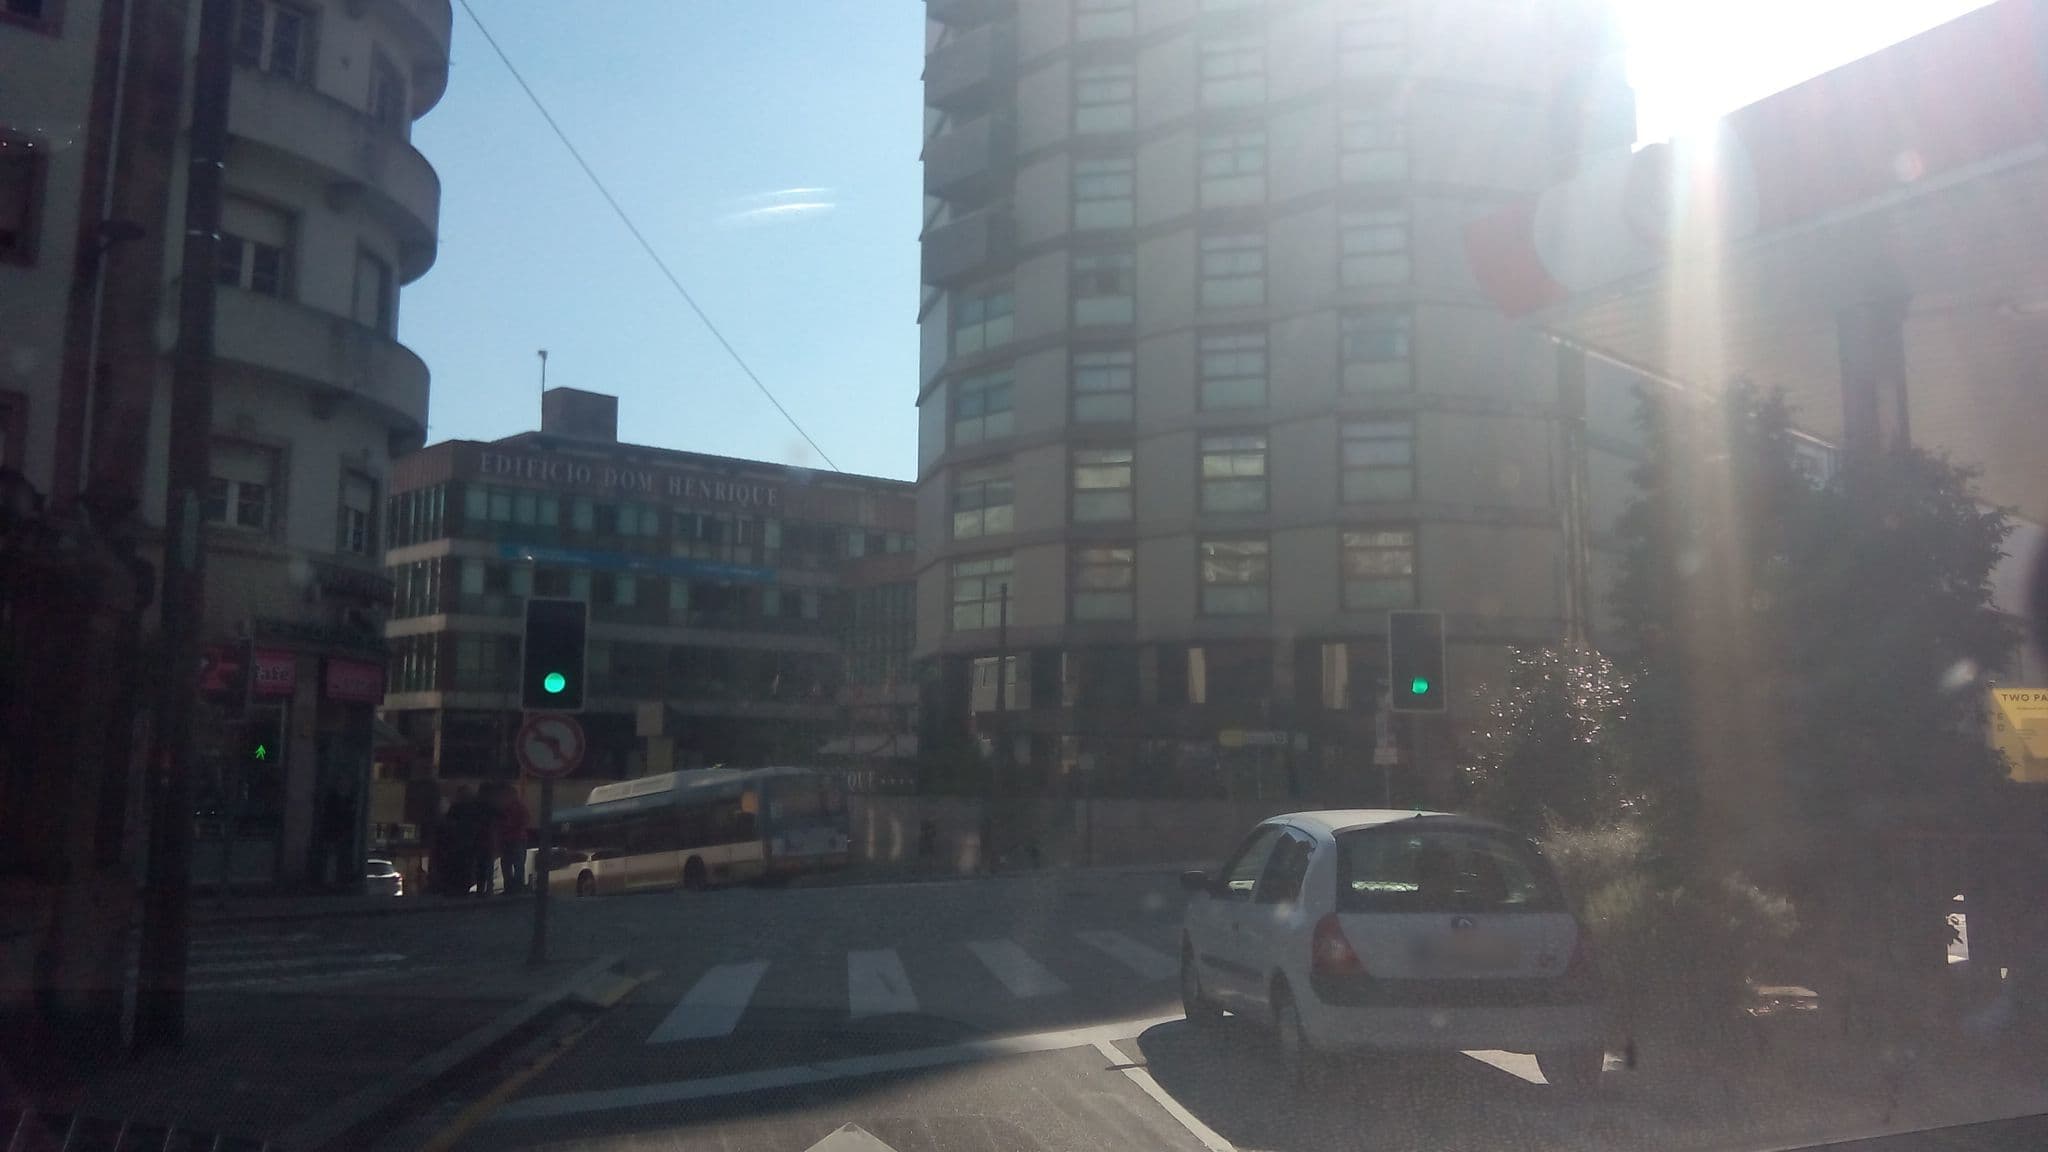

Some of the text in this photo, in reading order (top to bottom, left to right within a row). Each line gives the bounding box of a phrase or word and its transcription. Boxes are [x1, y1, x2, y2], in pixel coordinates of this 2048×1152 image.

[604, 467, 655, 493] DOM
[669, 475, 778, 507] HENRIQUE
[2001, 693, 2030, 702] TWO
